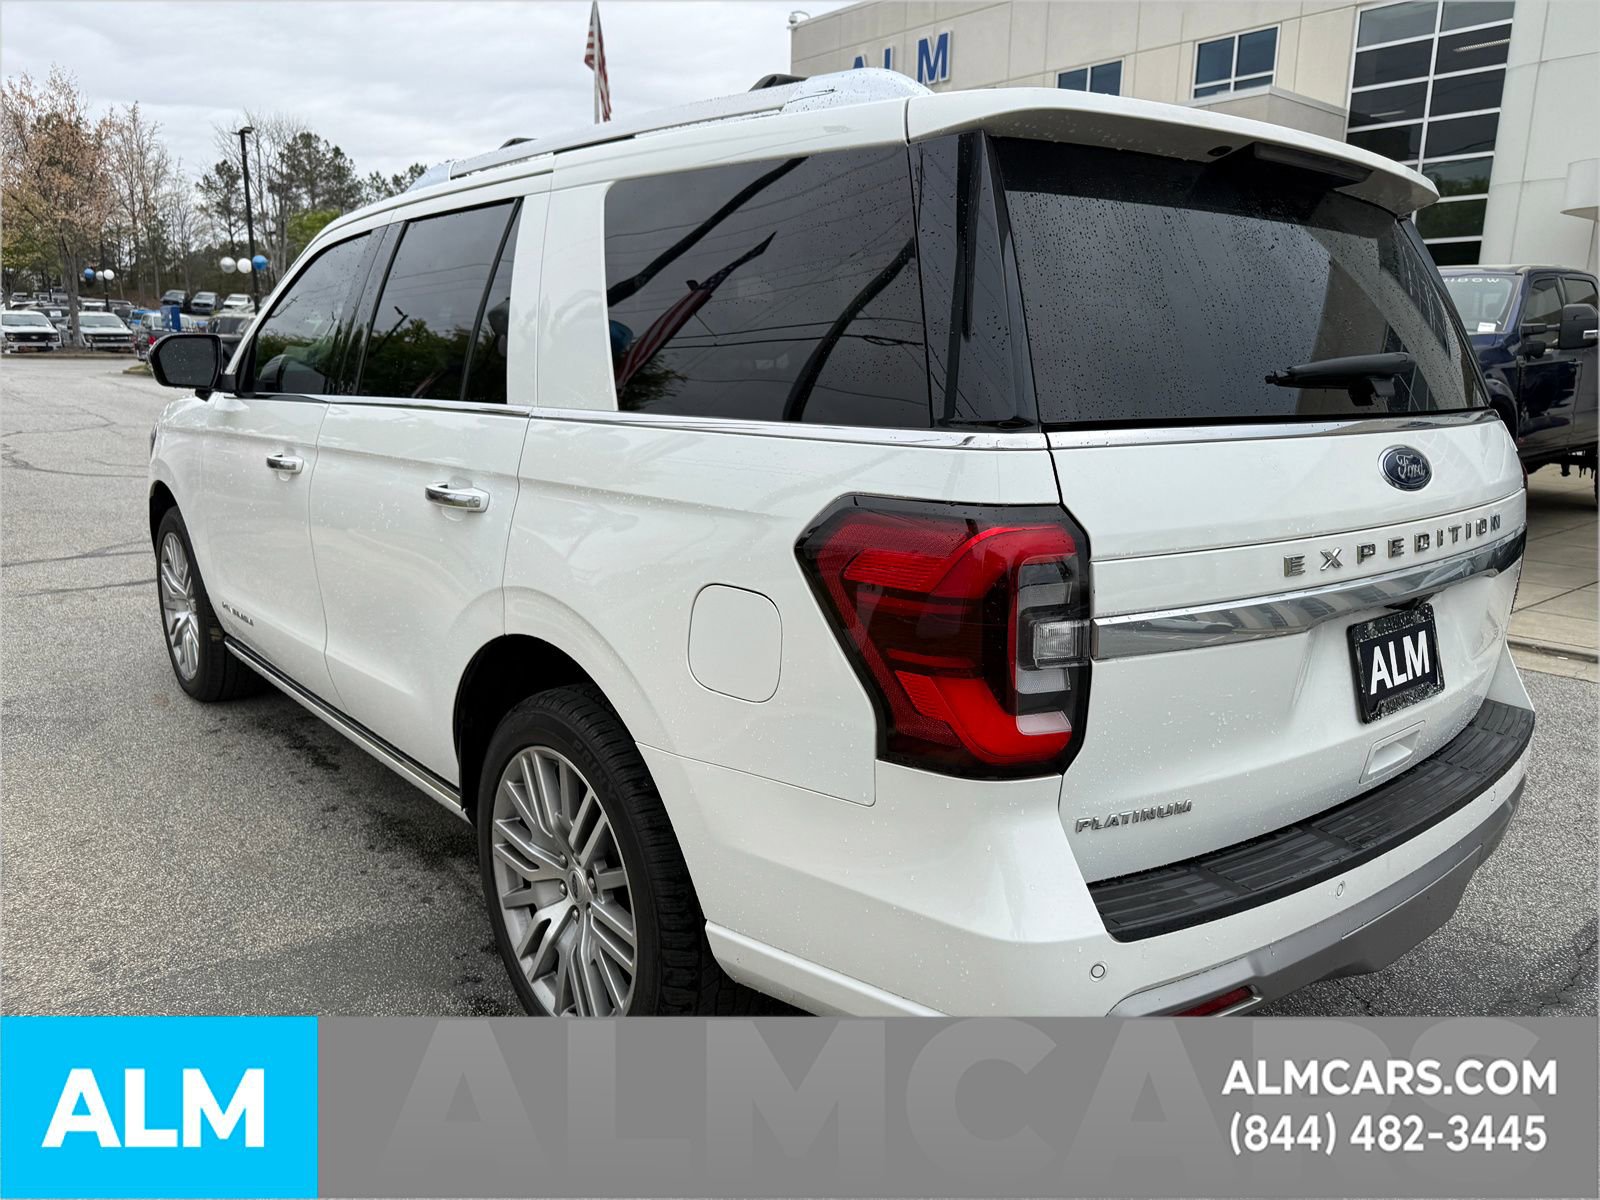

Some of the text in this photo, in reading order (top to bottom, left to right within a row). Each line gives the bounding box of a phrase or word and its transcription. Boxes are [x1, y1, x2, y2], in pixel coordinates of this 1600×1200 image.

[1395, 453, 1426, 480] Ford
[1283, 512, 1501, 578] EXPEDITION
[1370, 629, 1430, 696] ALM
[1075, 799, 1192, 834] PLATINUM
